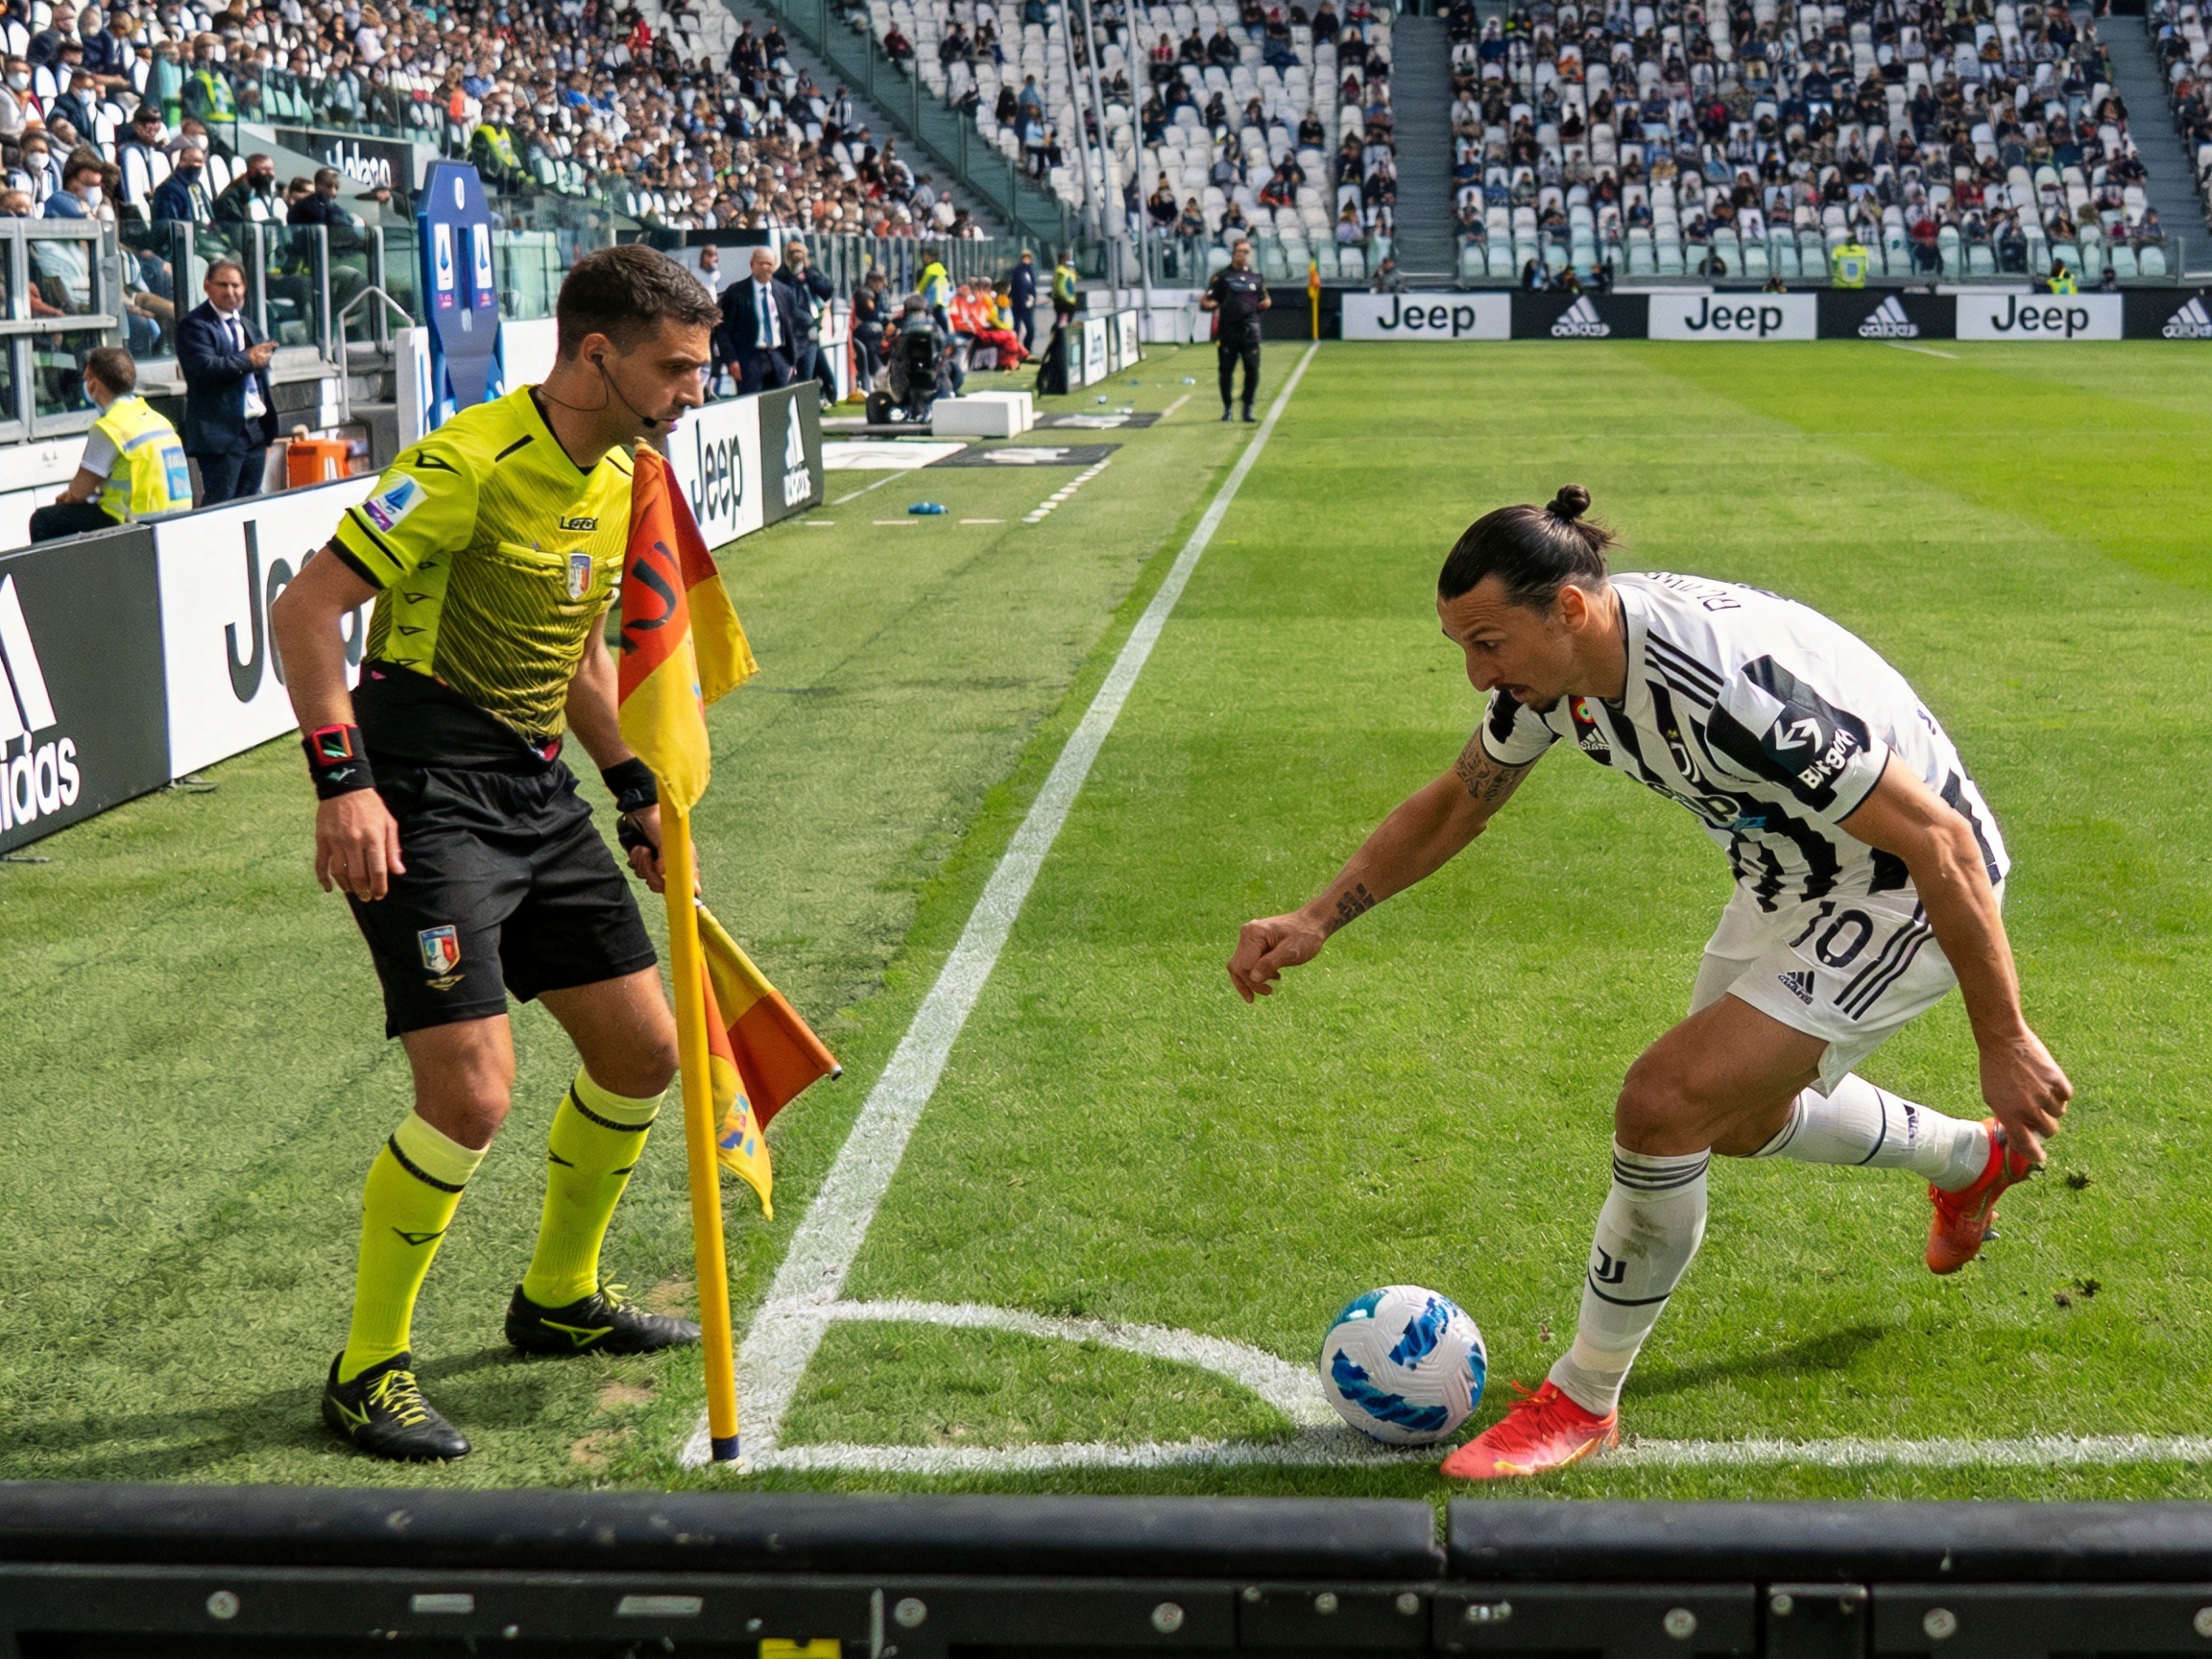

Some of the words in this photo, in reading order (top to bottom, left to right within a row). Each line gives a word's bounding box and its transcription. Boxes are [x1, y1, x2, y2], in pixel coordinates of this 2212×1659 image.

[1377, 296, 1475, 337] Jeep
[1684, 296, 1782, 337] Jeep
[1991, 296, 2089, 337] Jeep
[690, 419, 742, 531] Jeep
[1789, 901, 1873, 968] 10
